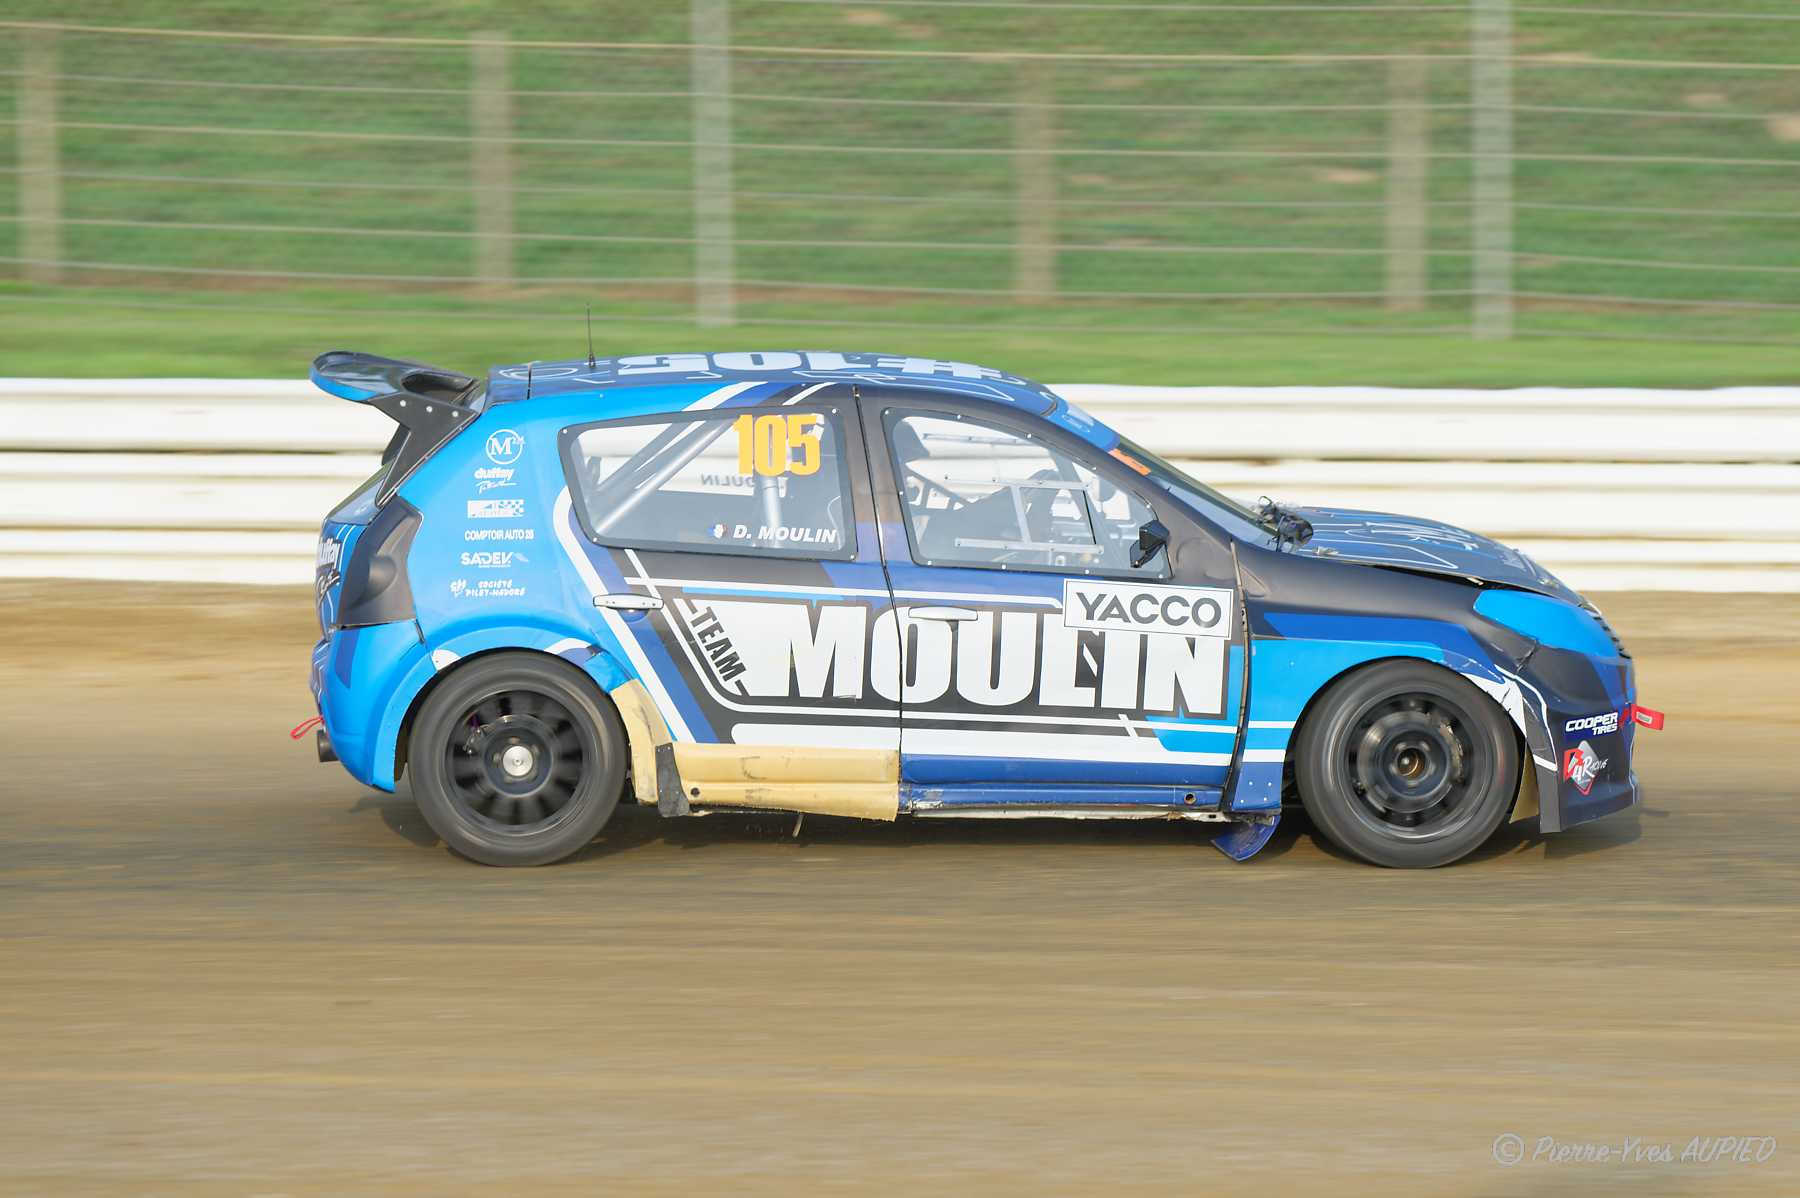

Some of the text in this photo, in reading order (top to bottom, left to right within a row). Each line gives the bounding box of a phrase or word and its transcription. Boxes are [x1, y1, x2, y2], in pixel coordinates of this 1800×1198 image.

[732, 413, 821, 477] 105
[505, 528, 525, 540] AUTO
[733, 524, 838, 543] D. MOULIN
[1076, 591, 1222, 629] YACCO
[691, 606, 747, 682] TEAM
[750, 602, 1226, 714] MOULIN
[1565, 712, 1618, 732] COOPER
[1592, 723, 1618, 736] TIRES
